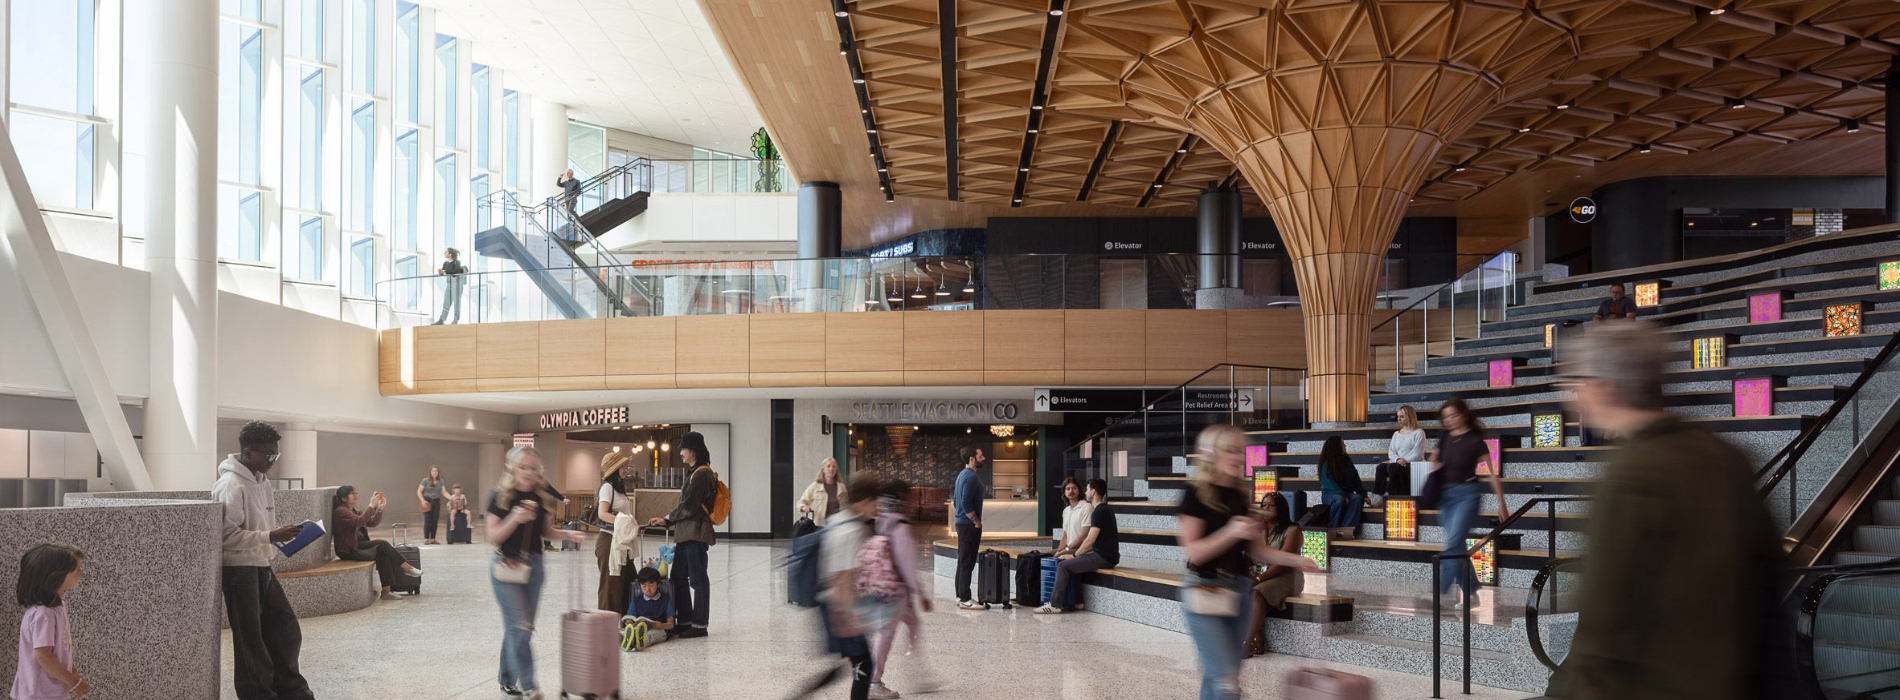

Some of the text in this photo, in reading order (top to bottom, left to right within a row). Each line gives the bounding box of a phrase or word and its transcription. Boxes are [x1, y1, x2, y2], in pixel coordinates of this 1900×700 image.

[1581, 205, 1595, 215] GO
[893, 241, 914, 256] SUBS
[1060, 396, 1087, 404] Elevators
[540, 407, 628, 430] OLYMPIA COFFEE
[852, 402, 1019, 420] SEATTLE MACARON CO
